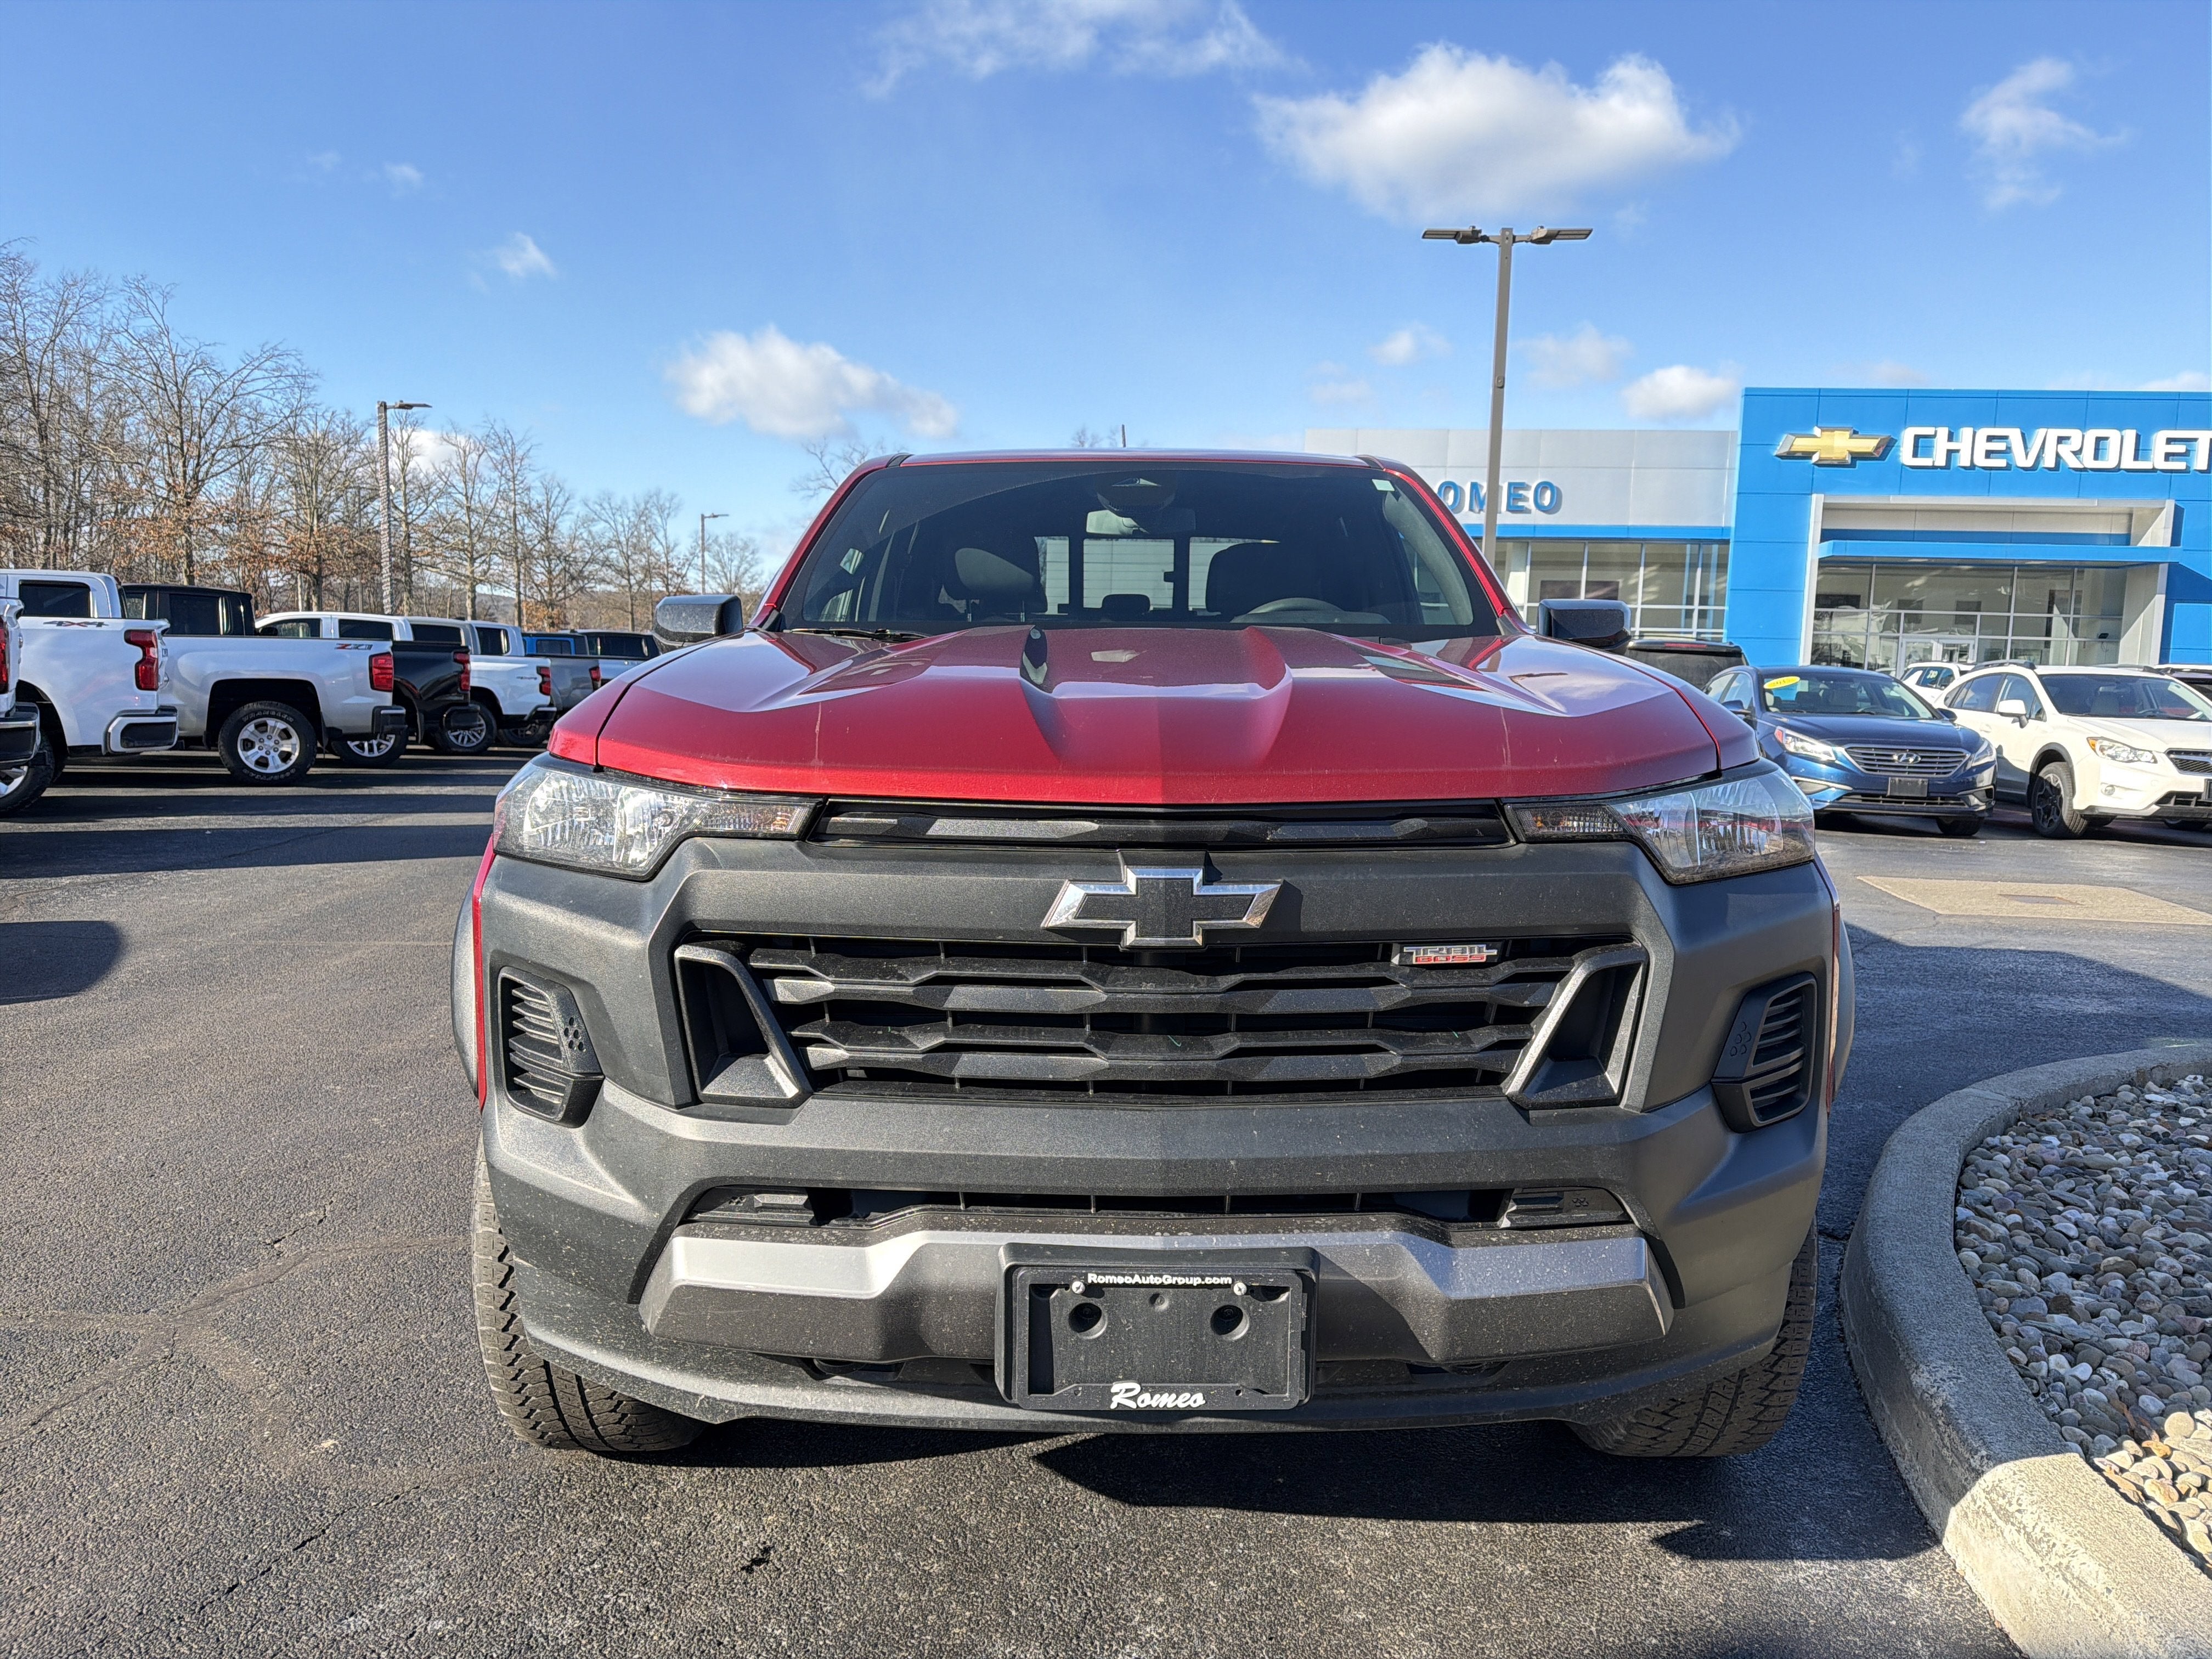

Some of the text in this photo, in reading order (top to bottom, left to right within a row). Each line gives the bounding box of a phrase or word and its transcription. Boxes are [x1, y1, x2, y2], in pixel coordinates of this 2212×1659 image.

[1901, 426, 2212, 470] CHEVROLET
[1436, 481, 1558, 511] OMEO
[1403, 944, 1498, 956] TRAIL
[1414, 953, 1487, 964] BOSS
[1087, 1272, 1233, 1286] RomeoAutoGroup.com
[1110, 1381, 1206, 1409] Romeo
